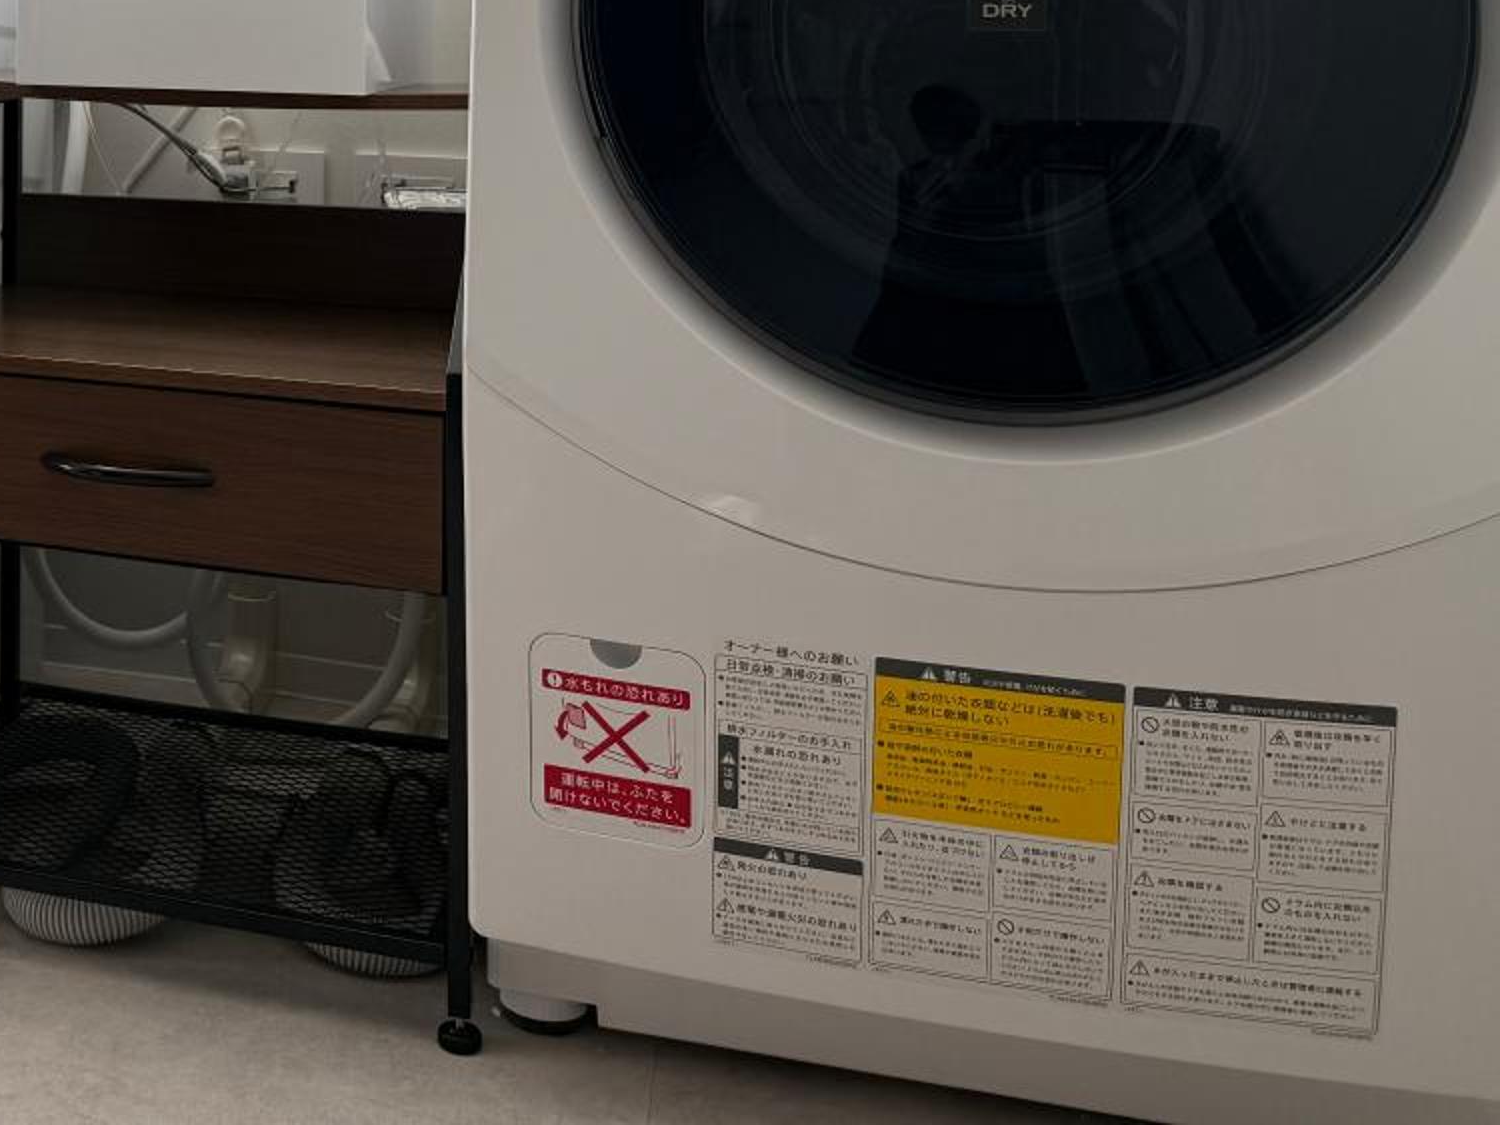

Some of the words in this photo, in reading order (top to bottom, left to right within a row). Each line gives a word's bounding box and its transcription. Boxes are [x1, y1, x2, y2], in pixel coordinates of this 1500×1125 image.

[982, 3, 1032, 18] DRY
[725, 640, 859, 666] オーナー様へのお願い
[565, 677, 684, 707] 水もれの恐れあり
[1189, 696, 1220, 712] 注意
[561, 772, 673, 804] 運転中は、ふたを
[550, 786, 686, 824] 開けないでください。
